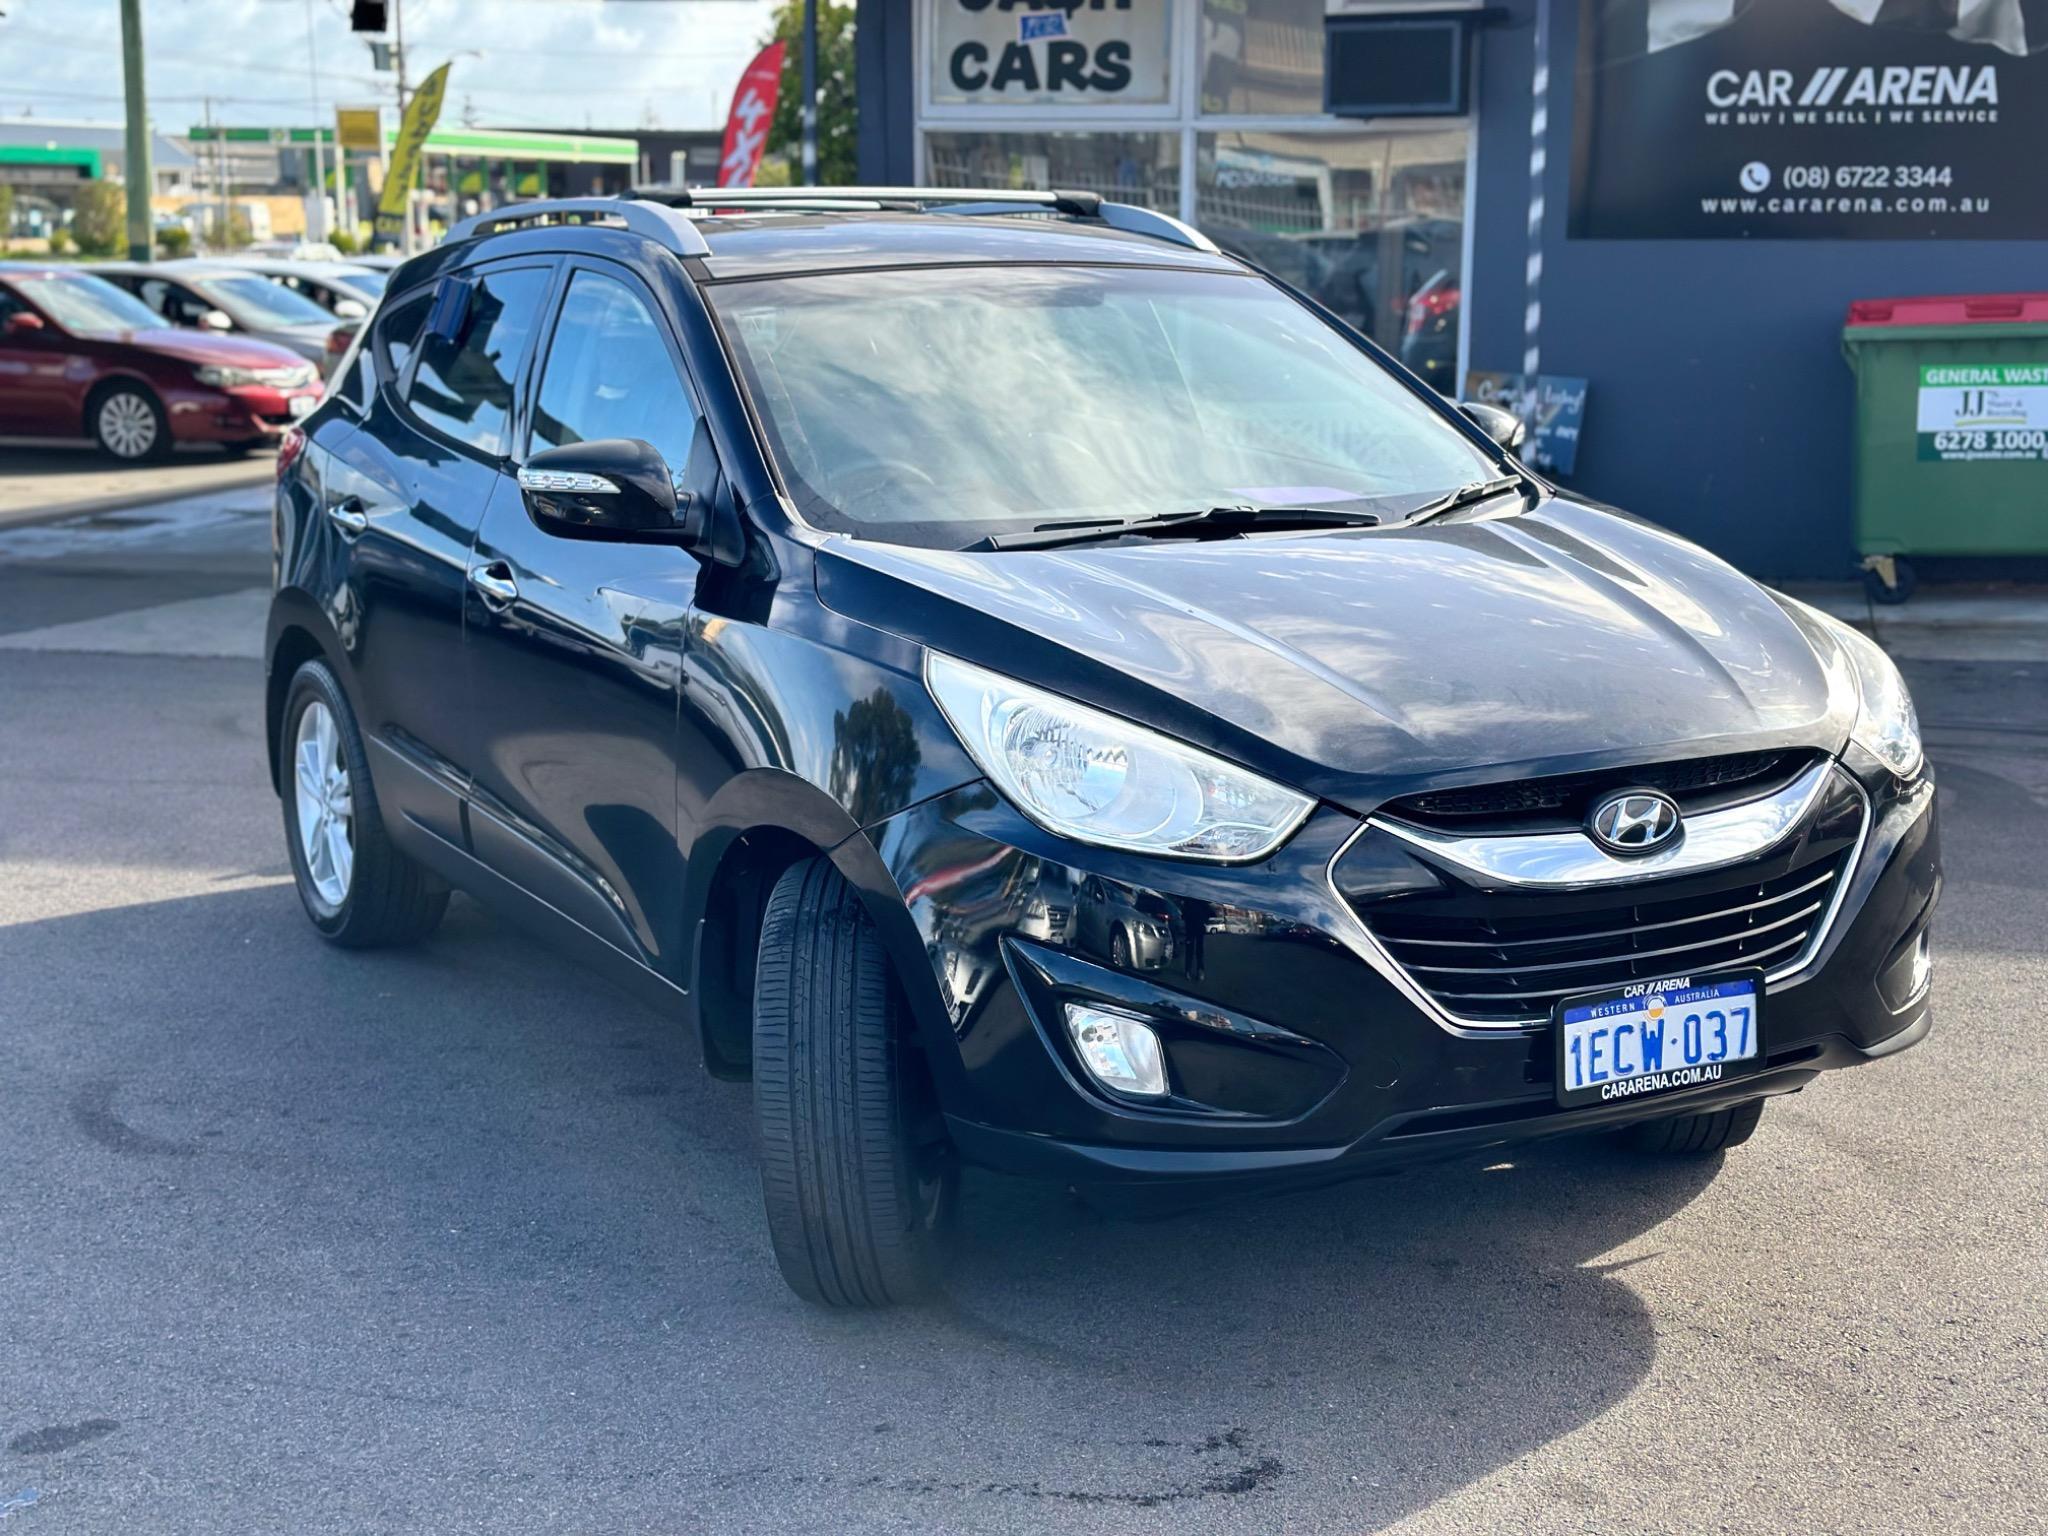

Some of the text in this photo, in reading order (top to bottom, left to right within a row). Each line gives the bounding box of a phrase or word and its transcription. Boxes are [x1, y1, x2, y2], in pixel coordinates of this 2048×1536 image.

[950, 40, 1132, 92] CARS
[1707, 69, 1793, 107] CAR
[1843, 65, 1998, 105] ARENA
[1705, 112, 1729, 125] WE
[1737, 111, 1772, 124] BUY
[1793, 111, 1817, 124] WE
[1825, 111, 1867, 124] SELL
[1890, 111, 1914, 124] WE
[1922, 110, 1998, 123] SERVICE
[1782, 165, 1952, 190] (08) 6722 3344
[1701, 196, 1990, 214] www.cararena.com.au
[1926, 368, 2000, 384] GENERAL
[1934, 431, 2045, 450] 6278 1000
[1624, 984, 1645, 998] CAR
[1654, 977, 1690, 993] ARENA
[1591, 988, 1720, 1018] WESTERN AUSTRALIA
[1601, 1064, 1722, 1100] CARARENA.COM.AU
